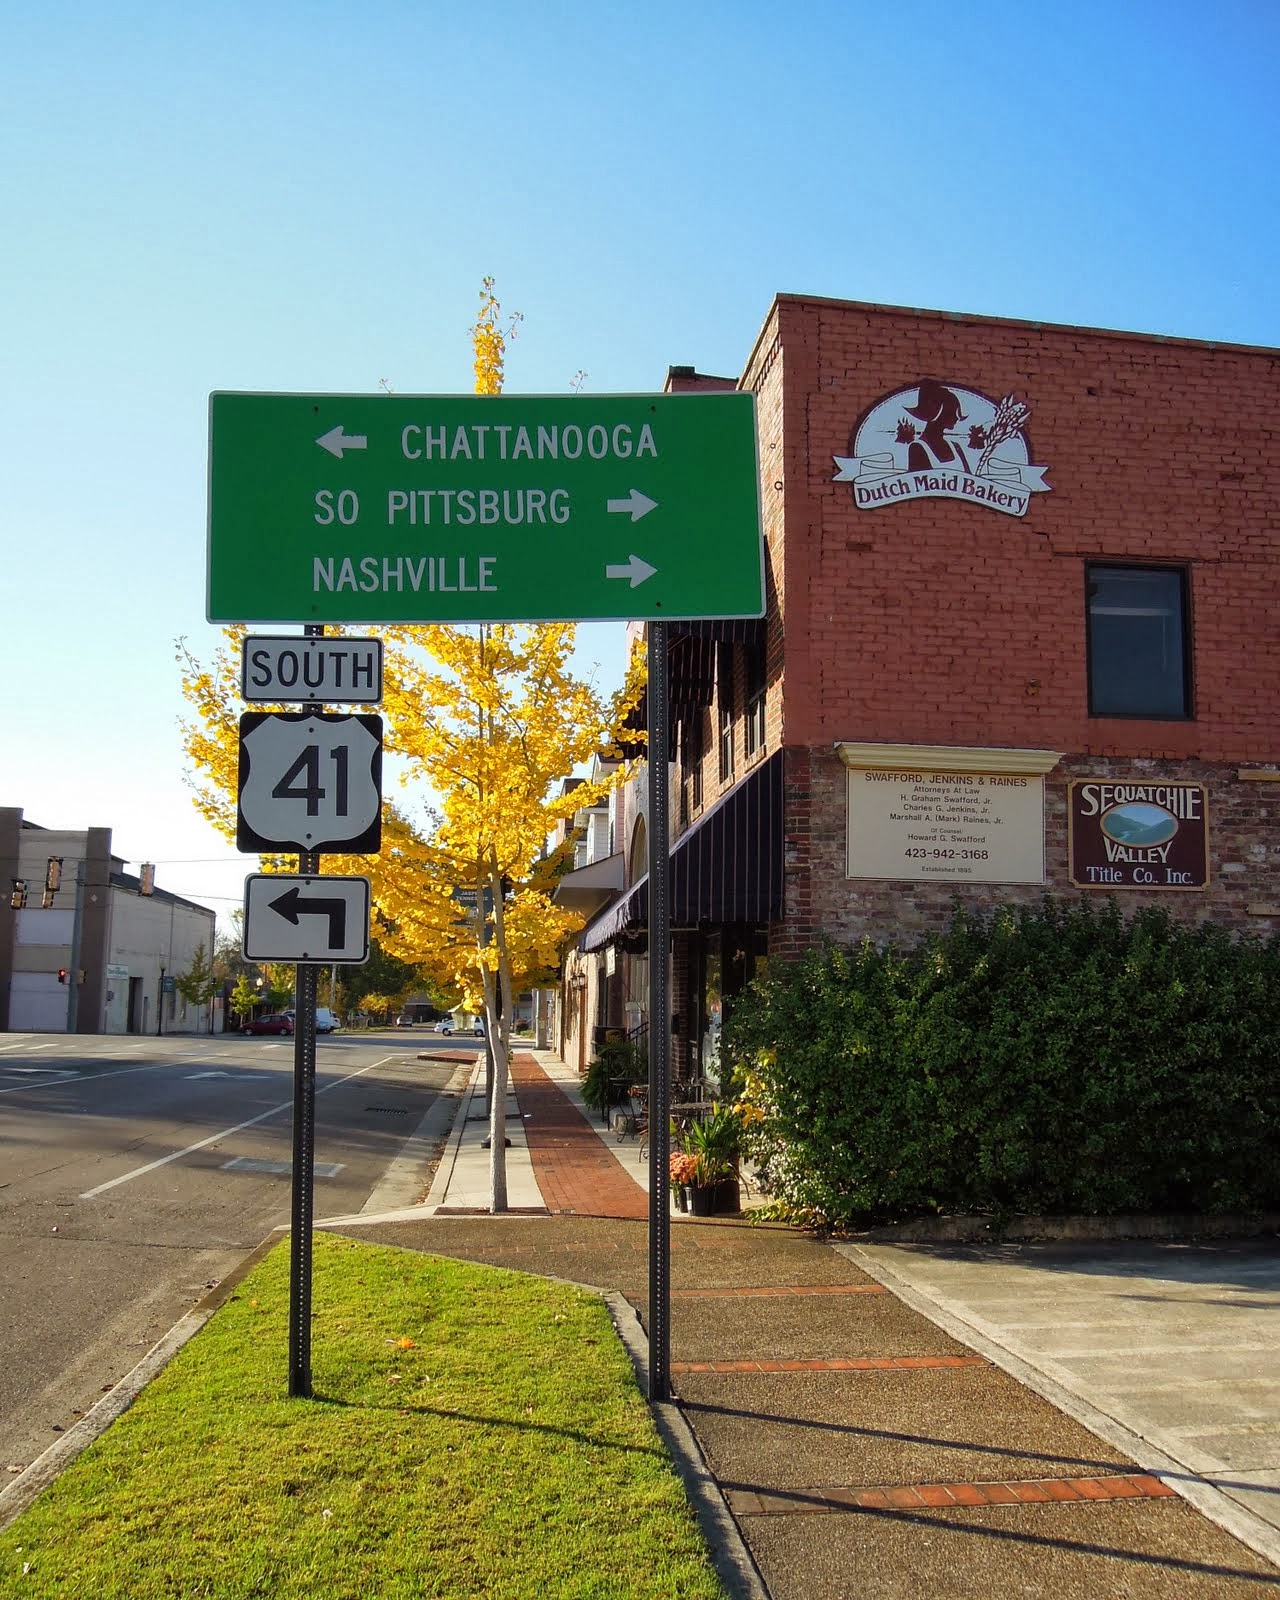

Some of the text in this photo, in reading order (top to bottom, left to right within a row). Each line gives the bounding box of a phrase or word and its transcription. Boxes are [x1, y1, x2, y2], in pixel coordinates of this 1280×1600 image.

[402, 424, 658, 459] CHATTANOOGA
[314, 489, 570, 525] SO PITTSBURG
[857, 473, 1027, 513] Dutch Maid Bakery
[313, 557, 497, 592] NASHVILLE
[251, 650, 373, 688] SOUTH
[272, 745, 348, 816] 41
[865, 773, 1027, 787] SWAFFORD, JENKINS & RAINES
[914, 786, 950, 794] Attorneys
[944, 796, 980, 804] Swafford,
[947, 806, 977, 814] Jenkins,
[1081, 785, 1201, 819] SEQUATCHIE
[905, 848, 989, 859] 423-942-3168
[1103, 836, 1173, 863] VALLEY
[1086, 866, 1122, 882] Title
[1166, 868, 1193, 884] Inc.
